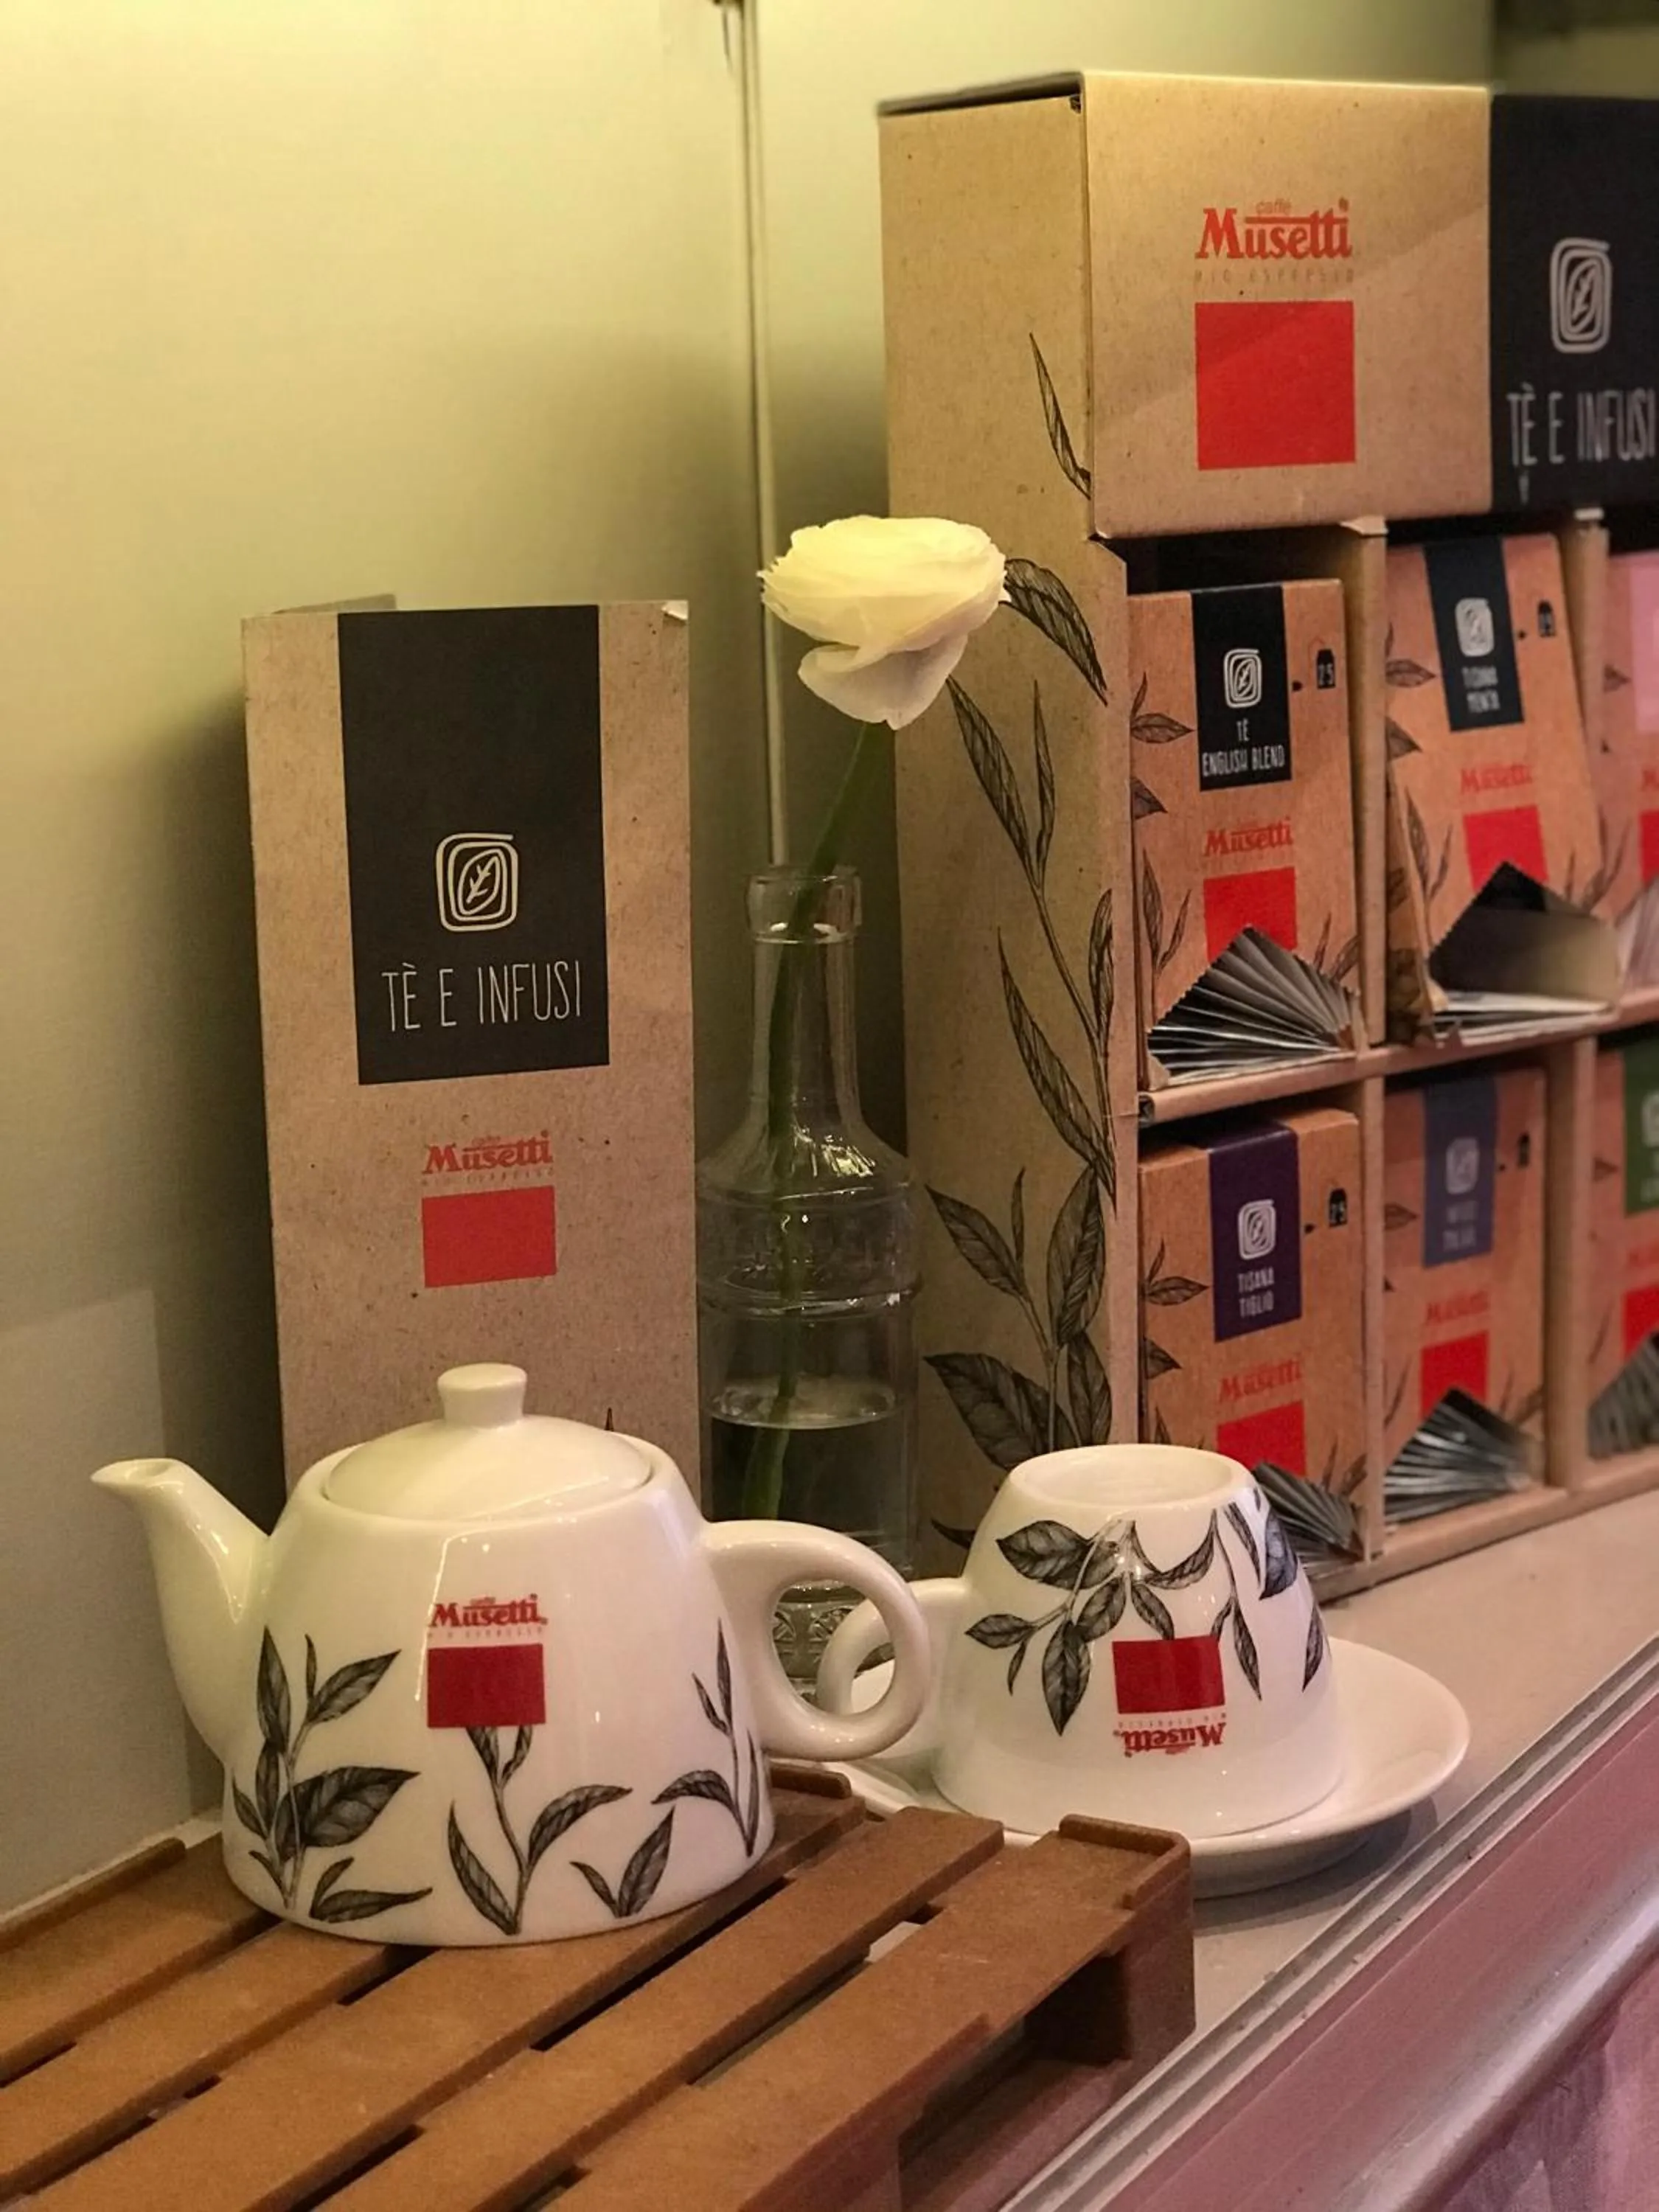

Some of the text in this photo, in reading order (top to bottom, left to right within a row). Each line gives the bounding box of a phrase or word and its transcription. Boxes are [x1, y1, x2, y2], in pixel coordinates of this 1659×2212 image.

[1194, 197, 1352, 260] Musetti
[1506, 381, 1656, 467] TÈ E INFUSI
[1202, 745, 1285, 777] ENGLISH BLEND
[1203, 815, 1294, 858] Musetti
[381, 960, 581, 1032] TÈ E INFUSI
[422, 1130, 554, 1175] Musetti
[428, 1593, 547, 1628] Musetti
[1113, 1722, 1226, 1758] Musetti
